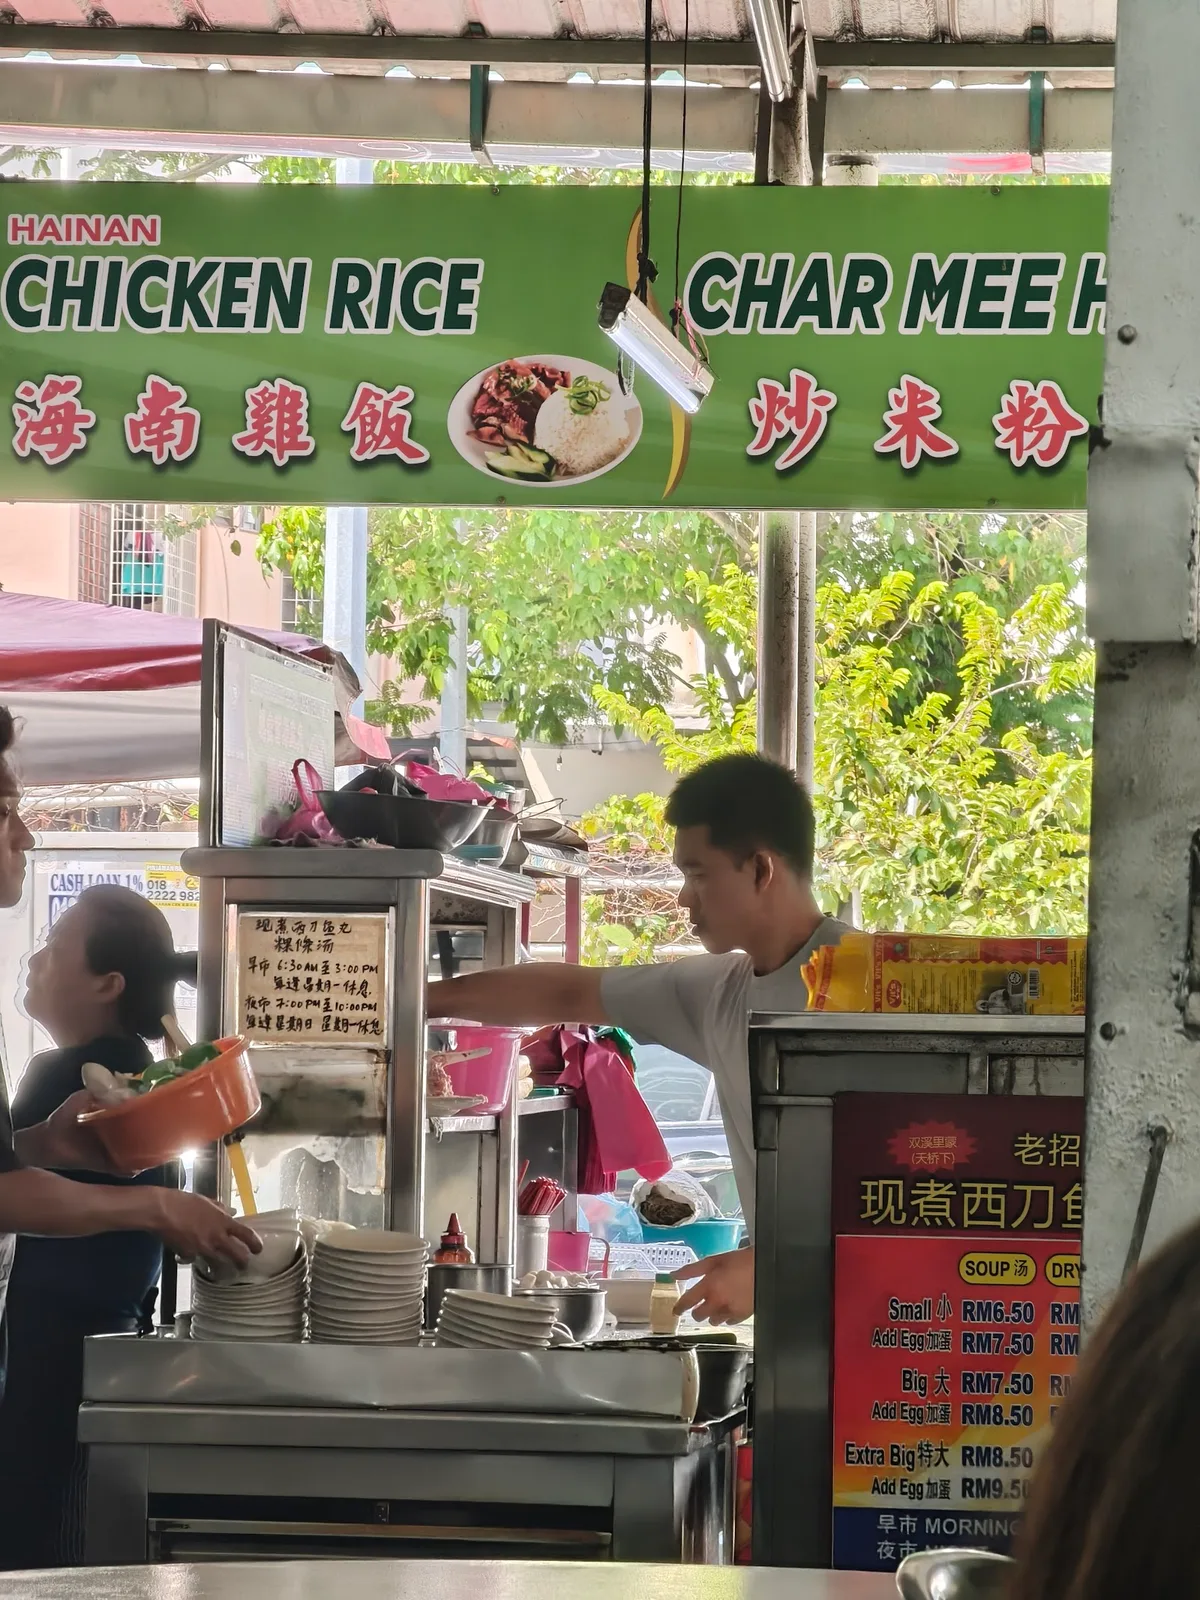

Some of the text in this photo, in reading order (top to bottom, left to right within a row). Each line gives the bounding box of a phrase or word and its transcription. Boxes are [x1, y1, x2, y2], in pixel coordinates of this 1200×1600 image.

[8, 214, 161, 246] HAINAN
[2, 254, 485, 335] CHICKEN RICE
[684, 251, 893, 335] CHAR
[900, 252, 1066, 335] MEE
[12, 374, 430, 468] 海南雞飯
[746, 368, 1089, 471] 炒米粉
[51, 873, 84, 891] CASH
[126, 874, 143, 892] 1%
[147, 880, 167, 890] 018
[147, 891, 176, 901] 2222
[248, 956, 270, 977] 早市
[321, 961, 332, 975] 至
[245, 995, 270, 1013] 夜市
[322, 997, 333, 1013] 至
[911, 1152, 955, 1165] (天桥下)
[1013, 1132, 1081, 1167] 老招
[965, 1259, 1028, 1277] SOUP 汤
[888, 1297, 932, 1323] Small
[936, 1293, 953, 1322] 小
[961, 1300, 1035, 1324] RM6.50
[872, 1329, 897, 1348] Add
[900, 1330, 924, 1351] Egg
[961, 1332, 1034, 1356] RM7.50
[901, 1369, 927, 1397] Big
[934, 1367, 951, 1397] 大
[961, 1372, 1034, 1396] RM7.50
[871, 1401, 897, 1421] Add
[900, 1402, 924, 1425] Egg
[961, 1403, 1034, 1427] RM8.50
[845, 1439, 1034, 1471] Extra Big 特大 RM8.50
[871, 1477, 897, 1496] Add
[900, 1478, 924, 1500] Egg
[877, 1514, 918, 1535] 早市
